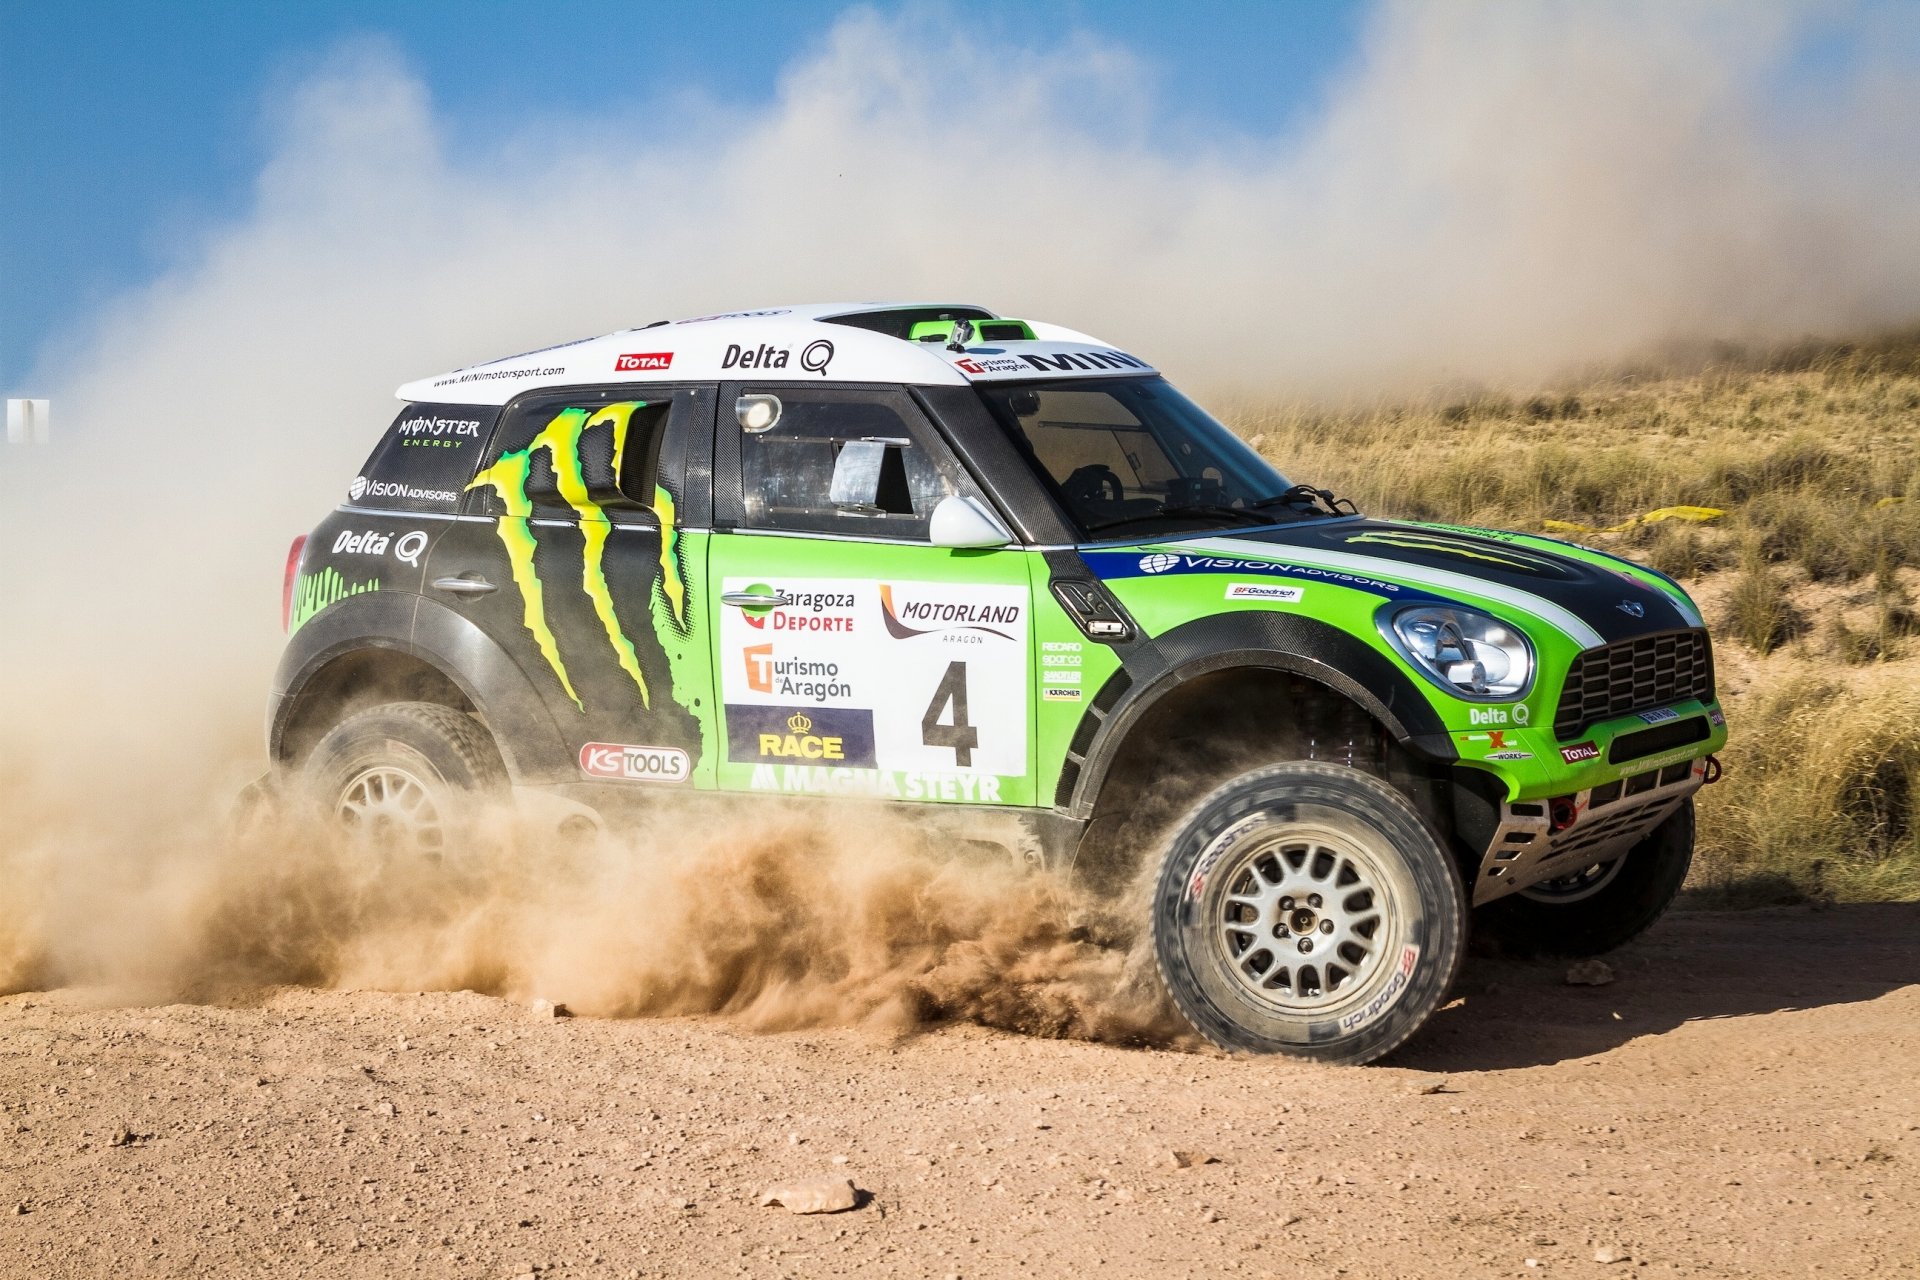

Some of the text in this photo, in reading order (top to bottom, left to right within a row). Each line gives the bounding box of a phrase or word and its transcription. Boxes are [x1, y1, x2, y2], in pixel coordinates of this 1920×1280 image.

[619, 355, 669, 368] TOTAL
[721, 343, 790, 369] Delta
[1017, 351, 1153, 371] MINI
[433, 366, 565, 388] www.MINImotorsport.com
[398, 416, 480, 438] MONSTER
[402, 439, 463, 448] ENERGY
[366, 480, 457, 501] VISION ADVISORS
[332, 530, 390, 555] Delta
[1184, 556, 1400, 592] VISION ADVISORS
[1233, 586, 1296, 598] BFGoodrich
[773, 611, 853, 632] DEPORTE
[902, 601, 1020, 623] MOTORLAND
[751, 653, 839, 685] Turismo
[780, 676, 851, 702] Aragón
[921, 660, 979, 767] 4
[1469, 707, 1508, 725] Delta
[758, 733, 845, 760] RACE
[1561, 745, 1598, 761] TOTAL
[587, 748, 680, 775] KS TOOLS
[904, 773, 1003, 802] STEYR
